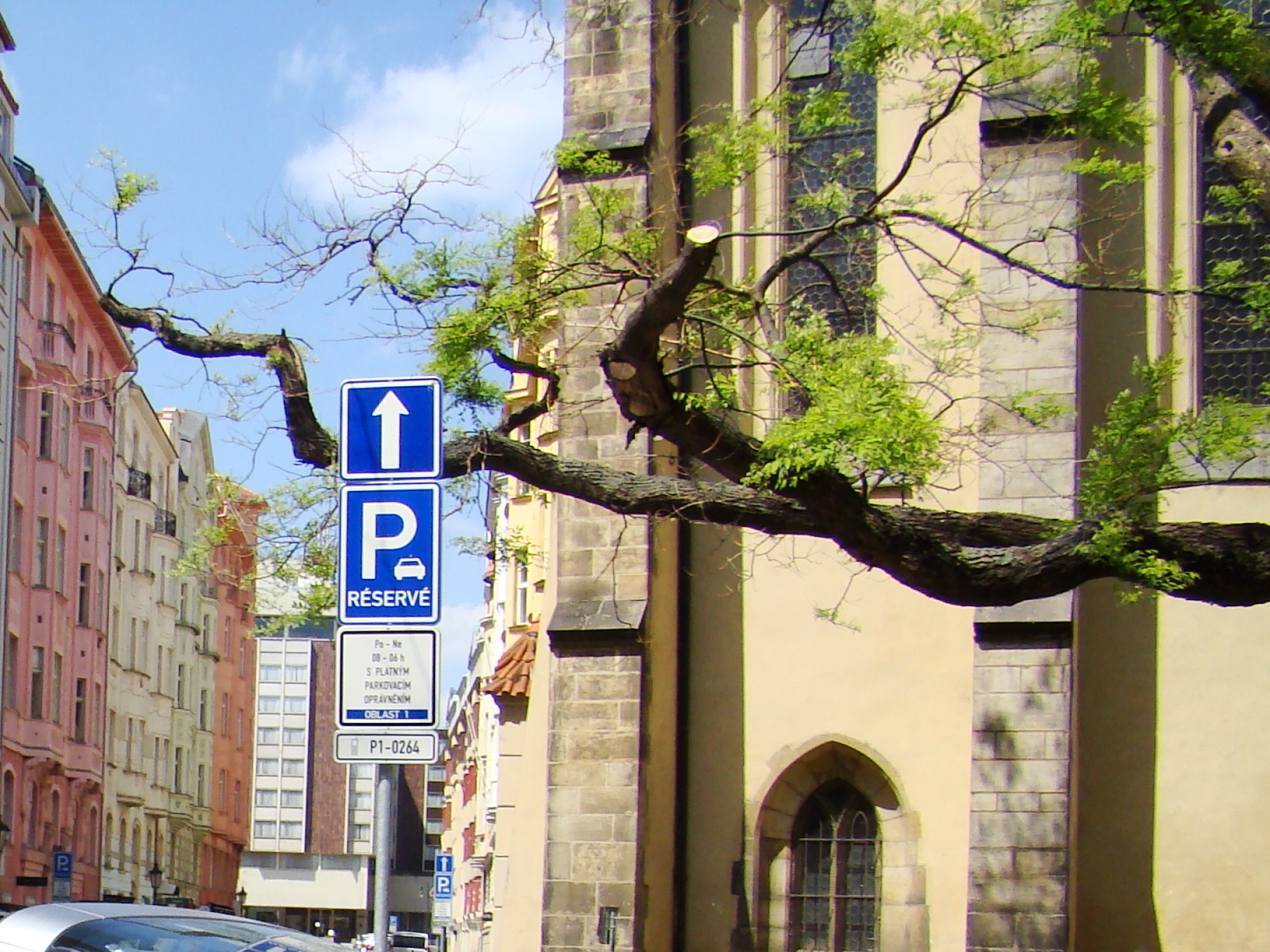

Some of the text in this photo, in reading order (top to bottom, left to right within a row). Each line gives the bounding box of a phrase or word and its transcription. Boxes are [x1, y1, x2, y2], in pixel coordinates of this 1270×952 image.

[361, 502, 418, 580] P
[347, 587, 431, 607] RÉSERVÉ
[374, 639, 384, 649] Po
[392, 639, 402, 649] Ne
[366, 665, 410, 676] S PLATNÝM
[364, 680, 412, 690] PARKOVACÍM
[364, 710, 410, 719] OBLAST 1
[369, 739, 420, 754] P1-0264
[57, 855, 69, 871] P
[437, 877, 450, 893] P
